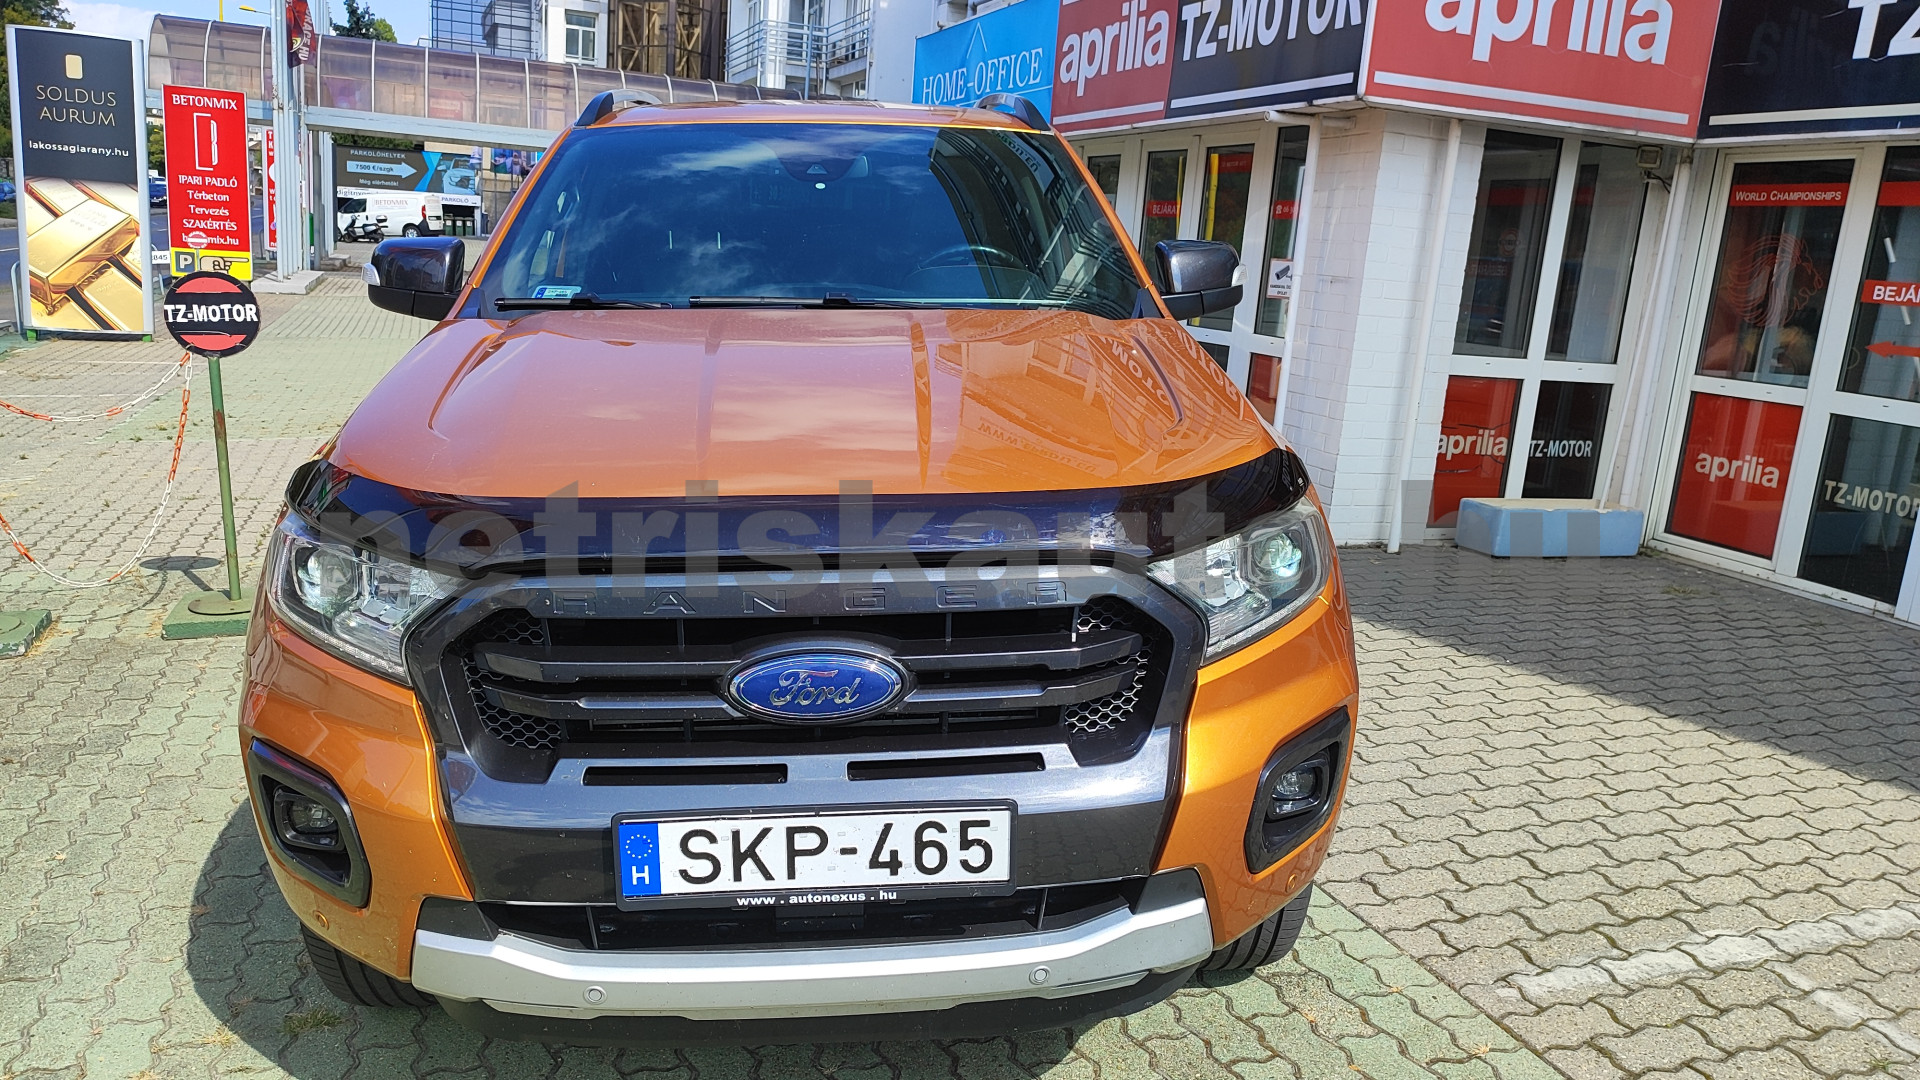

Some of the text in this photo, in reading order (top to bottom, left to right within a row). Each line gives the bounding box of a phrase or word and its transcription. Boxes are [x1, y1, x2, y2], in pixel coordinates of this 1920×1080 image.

[1060, 0, 1170, 97] aprilia
[922, 48, 1043, 105] HOME-OFFICE
[36, 85, 116, 107] SOLDUS
[171, 94, 238, 110] BETONMIX
[40, 106, 115, 126] AURUM
[29, 140, 129, 157] lakossagiarany.hu
[178, 175, 238, 188] IPARI PADLÓ
[187, 190, 230, 202] Térbeton
[1735, 190, 1842, 202] WORLD CHAMPIONSHIPS
[188, 205, 230, 216] Tervezés
[183, 218, 238, 231] SZAKÉRTÉS
[182, 233, 240, 246] bmix.hu
[163, 303, 259, 323] TZ-MOTOR
[1438, 429, 1508, 461] aprilia
[1530, 439, 1593, 458] TZ-MOTOR
[1695, 453, 1780, 489] aprilia
[553, 580, 1068, 615] RANGER
[769, 669, 861, 706] Ford
[631, 819, 994, 885] H SKP-465
